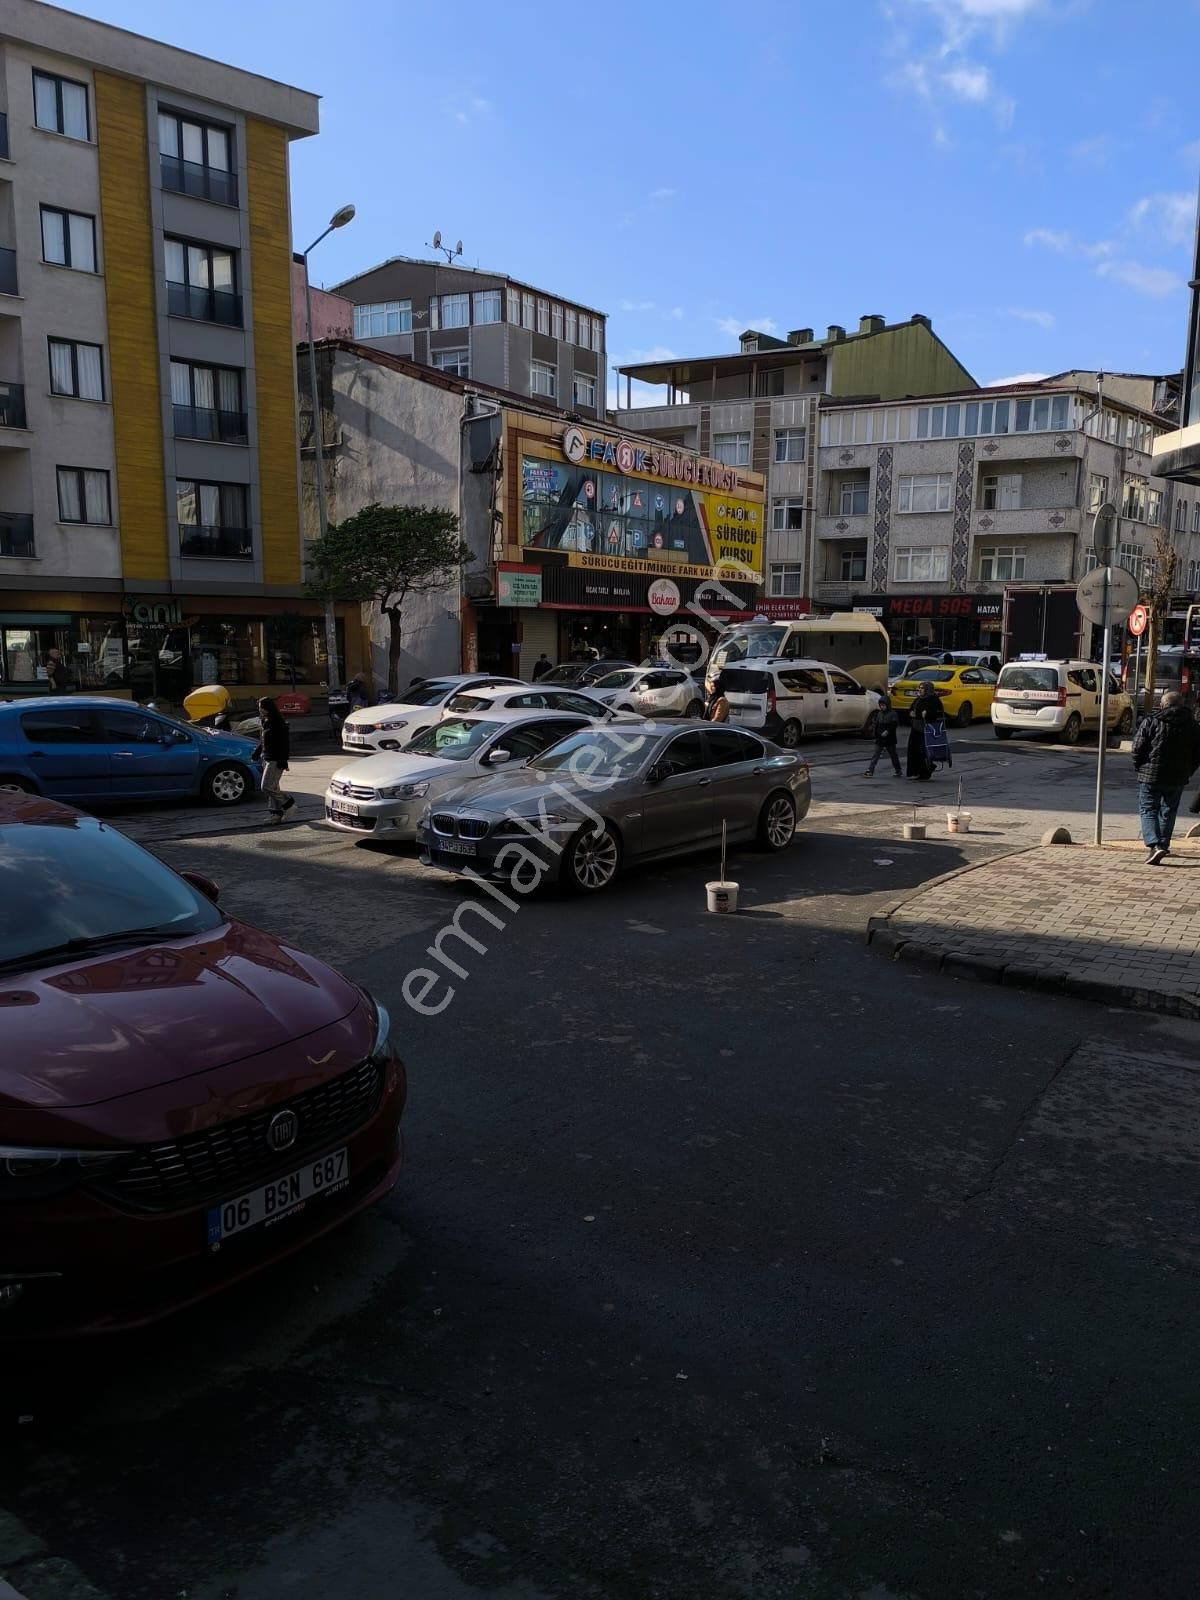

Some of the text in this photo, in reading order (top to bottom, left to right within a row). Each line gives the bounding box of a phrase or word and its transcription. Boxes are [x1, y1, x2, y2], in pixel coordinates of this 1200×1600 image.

[651, 450, 699, 482] SÜRÜCÜ
[703, 465, 738, 491] KURSU
[716, 523, 757, 545] SÜRÜCÜ
[581, 555, 619, 570] SÜRÜCÜ
[621, 557, 677, 574] EĞİTİMİNDE
[679, 565, 698, 576] FARK
[720, 546, 753, 564] KURSU
[771, 602, 801, 612] ELEKTRİK
[889, 597, 1000, 615] MEGA SOS HATAY
[223, 1199, 250, 1232] 06
[264, 1173, 301, 1214] BSN
[312, 1151, 346, 1189] 687
